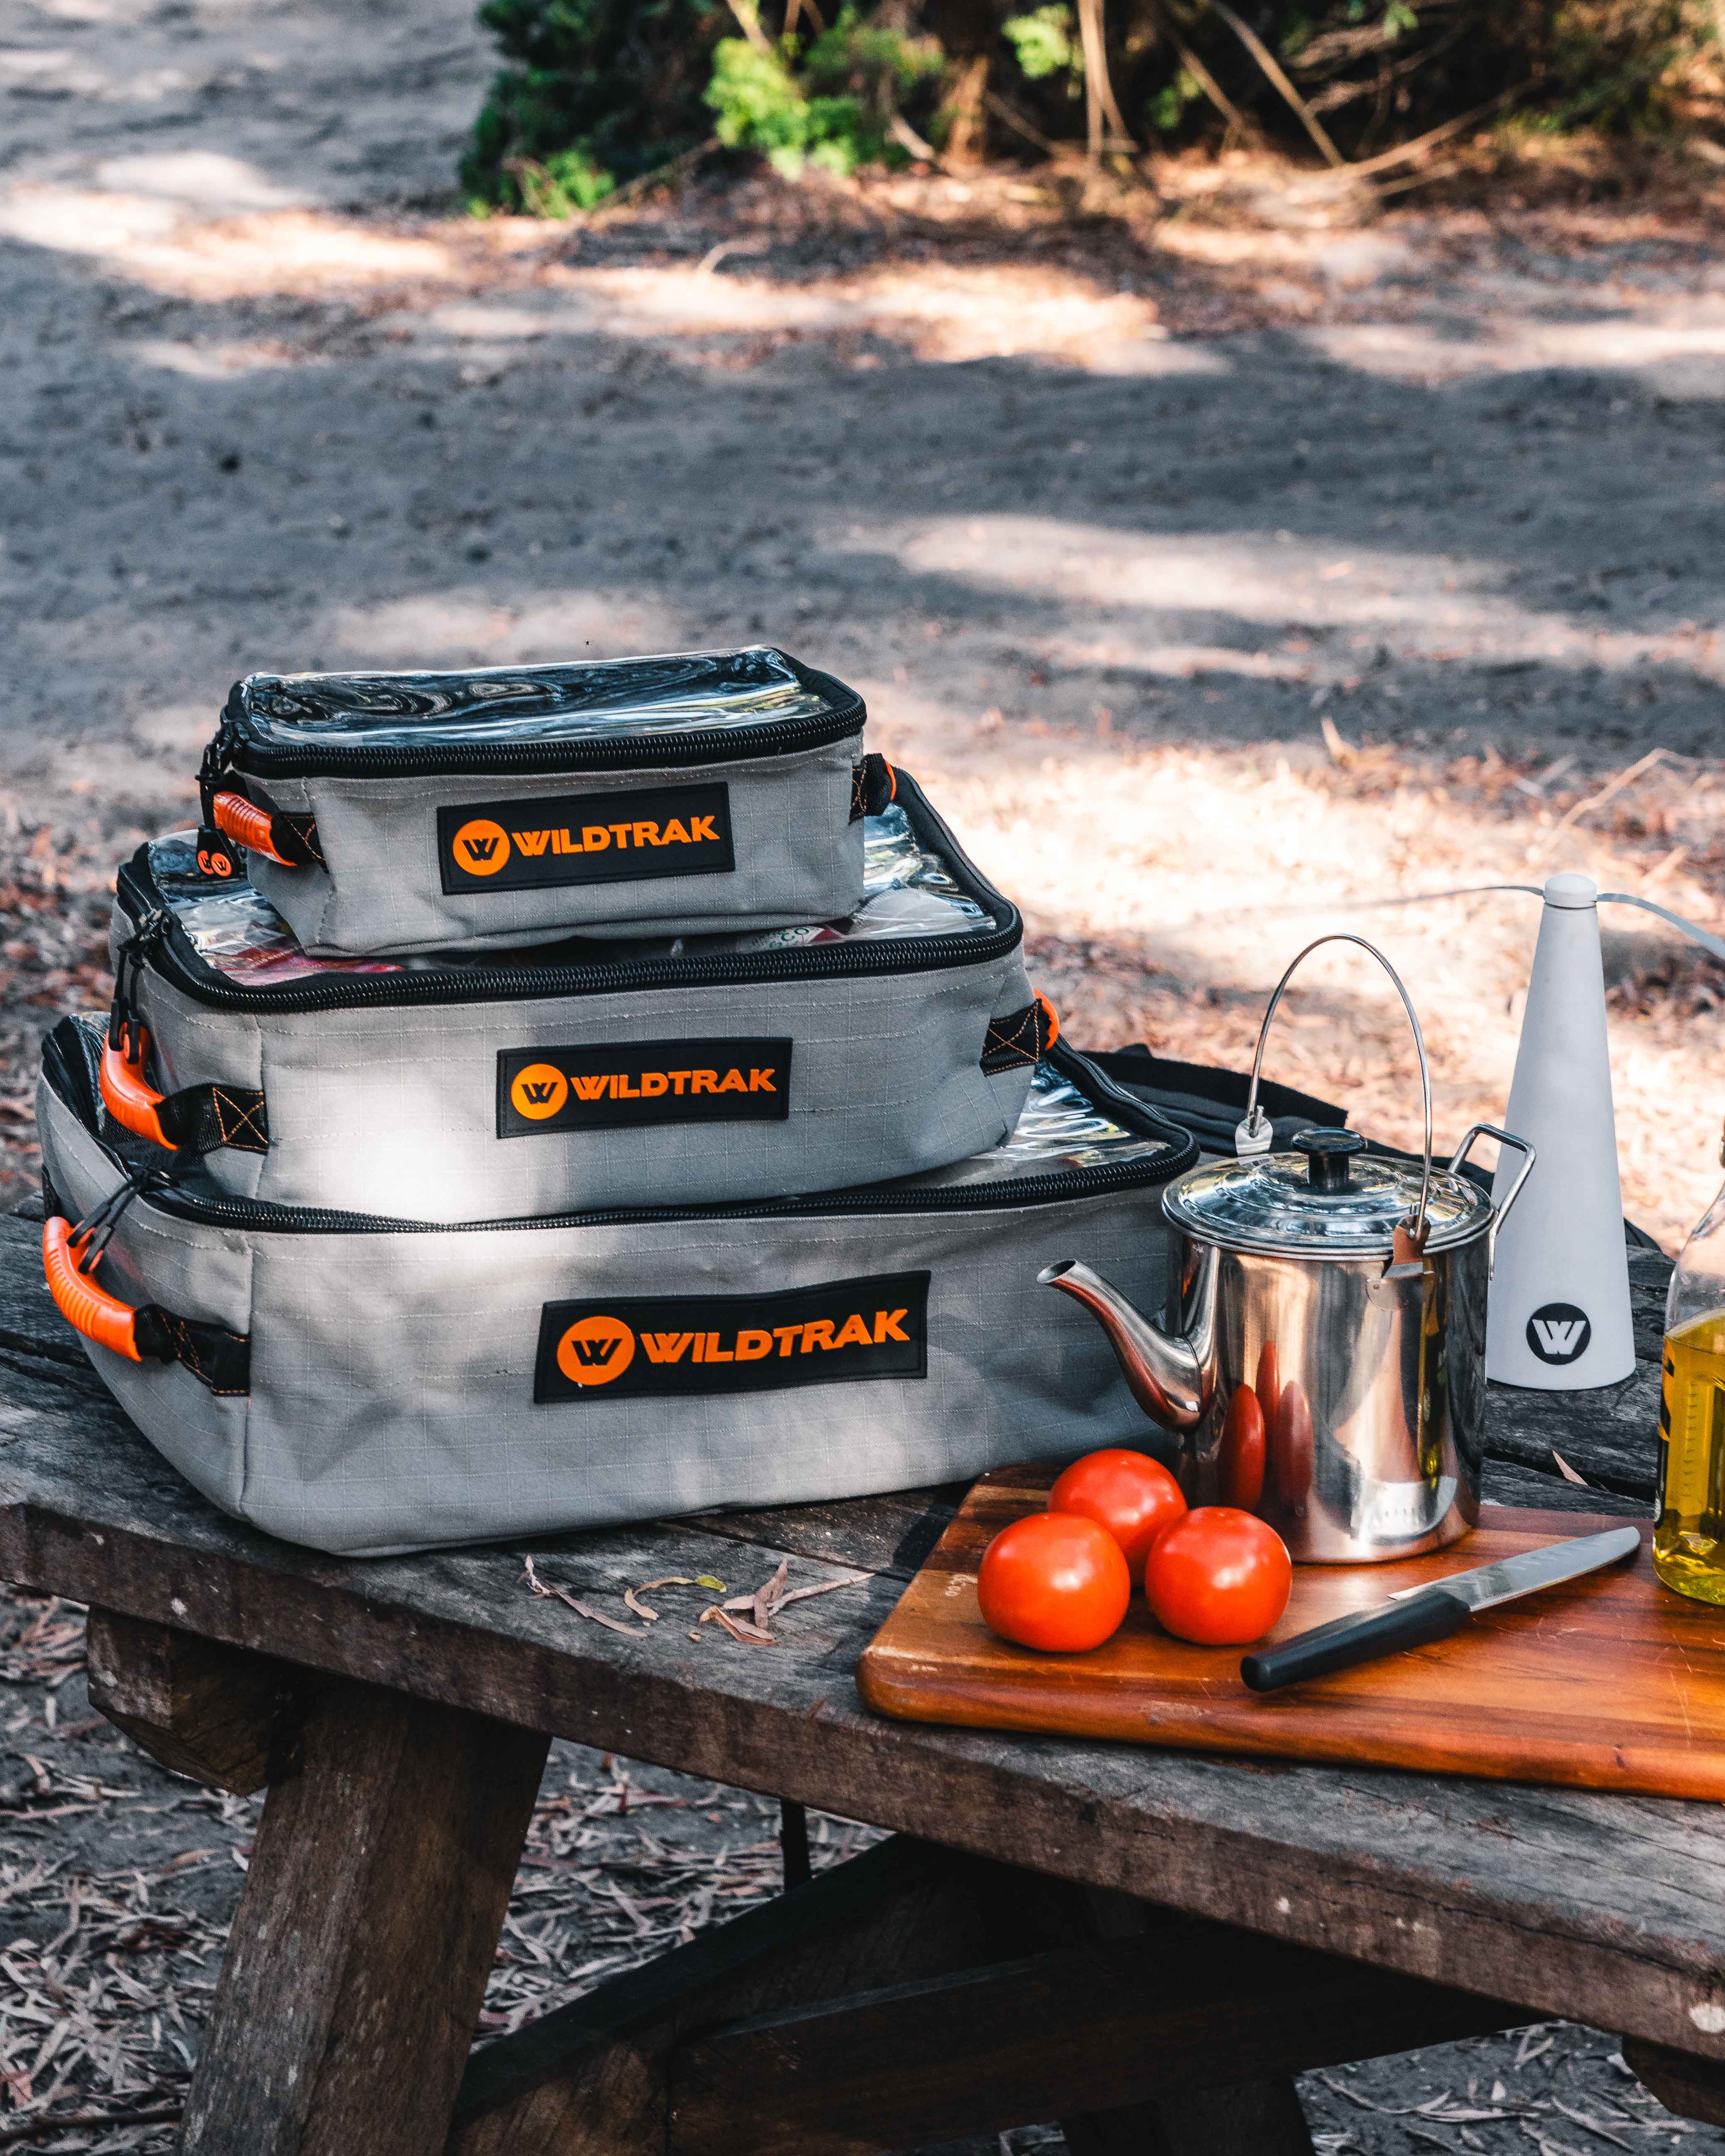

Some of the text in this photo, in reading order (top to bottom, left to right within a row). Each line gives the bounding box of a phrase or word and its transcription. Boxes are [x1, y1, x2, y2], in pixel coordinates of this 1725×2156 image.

[462, 815, 720, 861] W WILDTRAK
[521, 1068, 777, 1104] W WILDTRAK
[572, 1309, 910, 1366] W WILDTRAK
[1532, 1319, 1586, 1355] W
